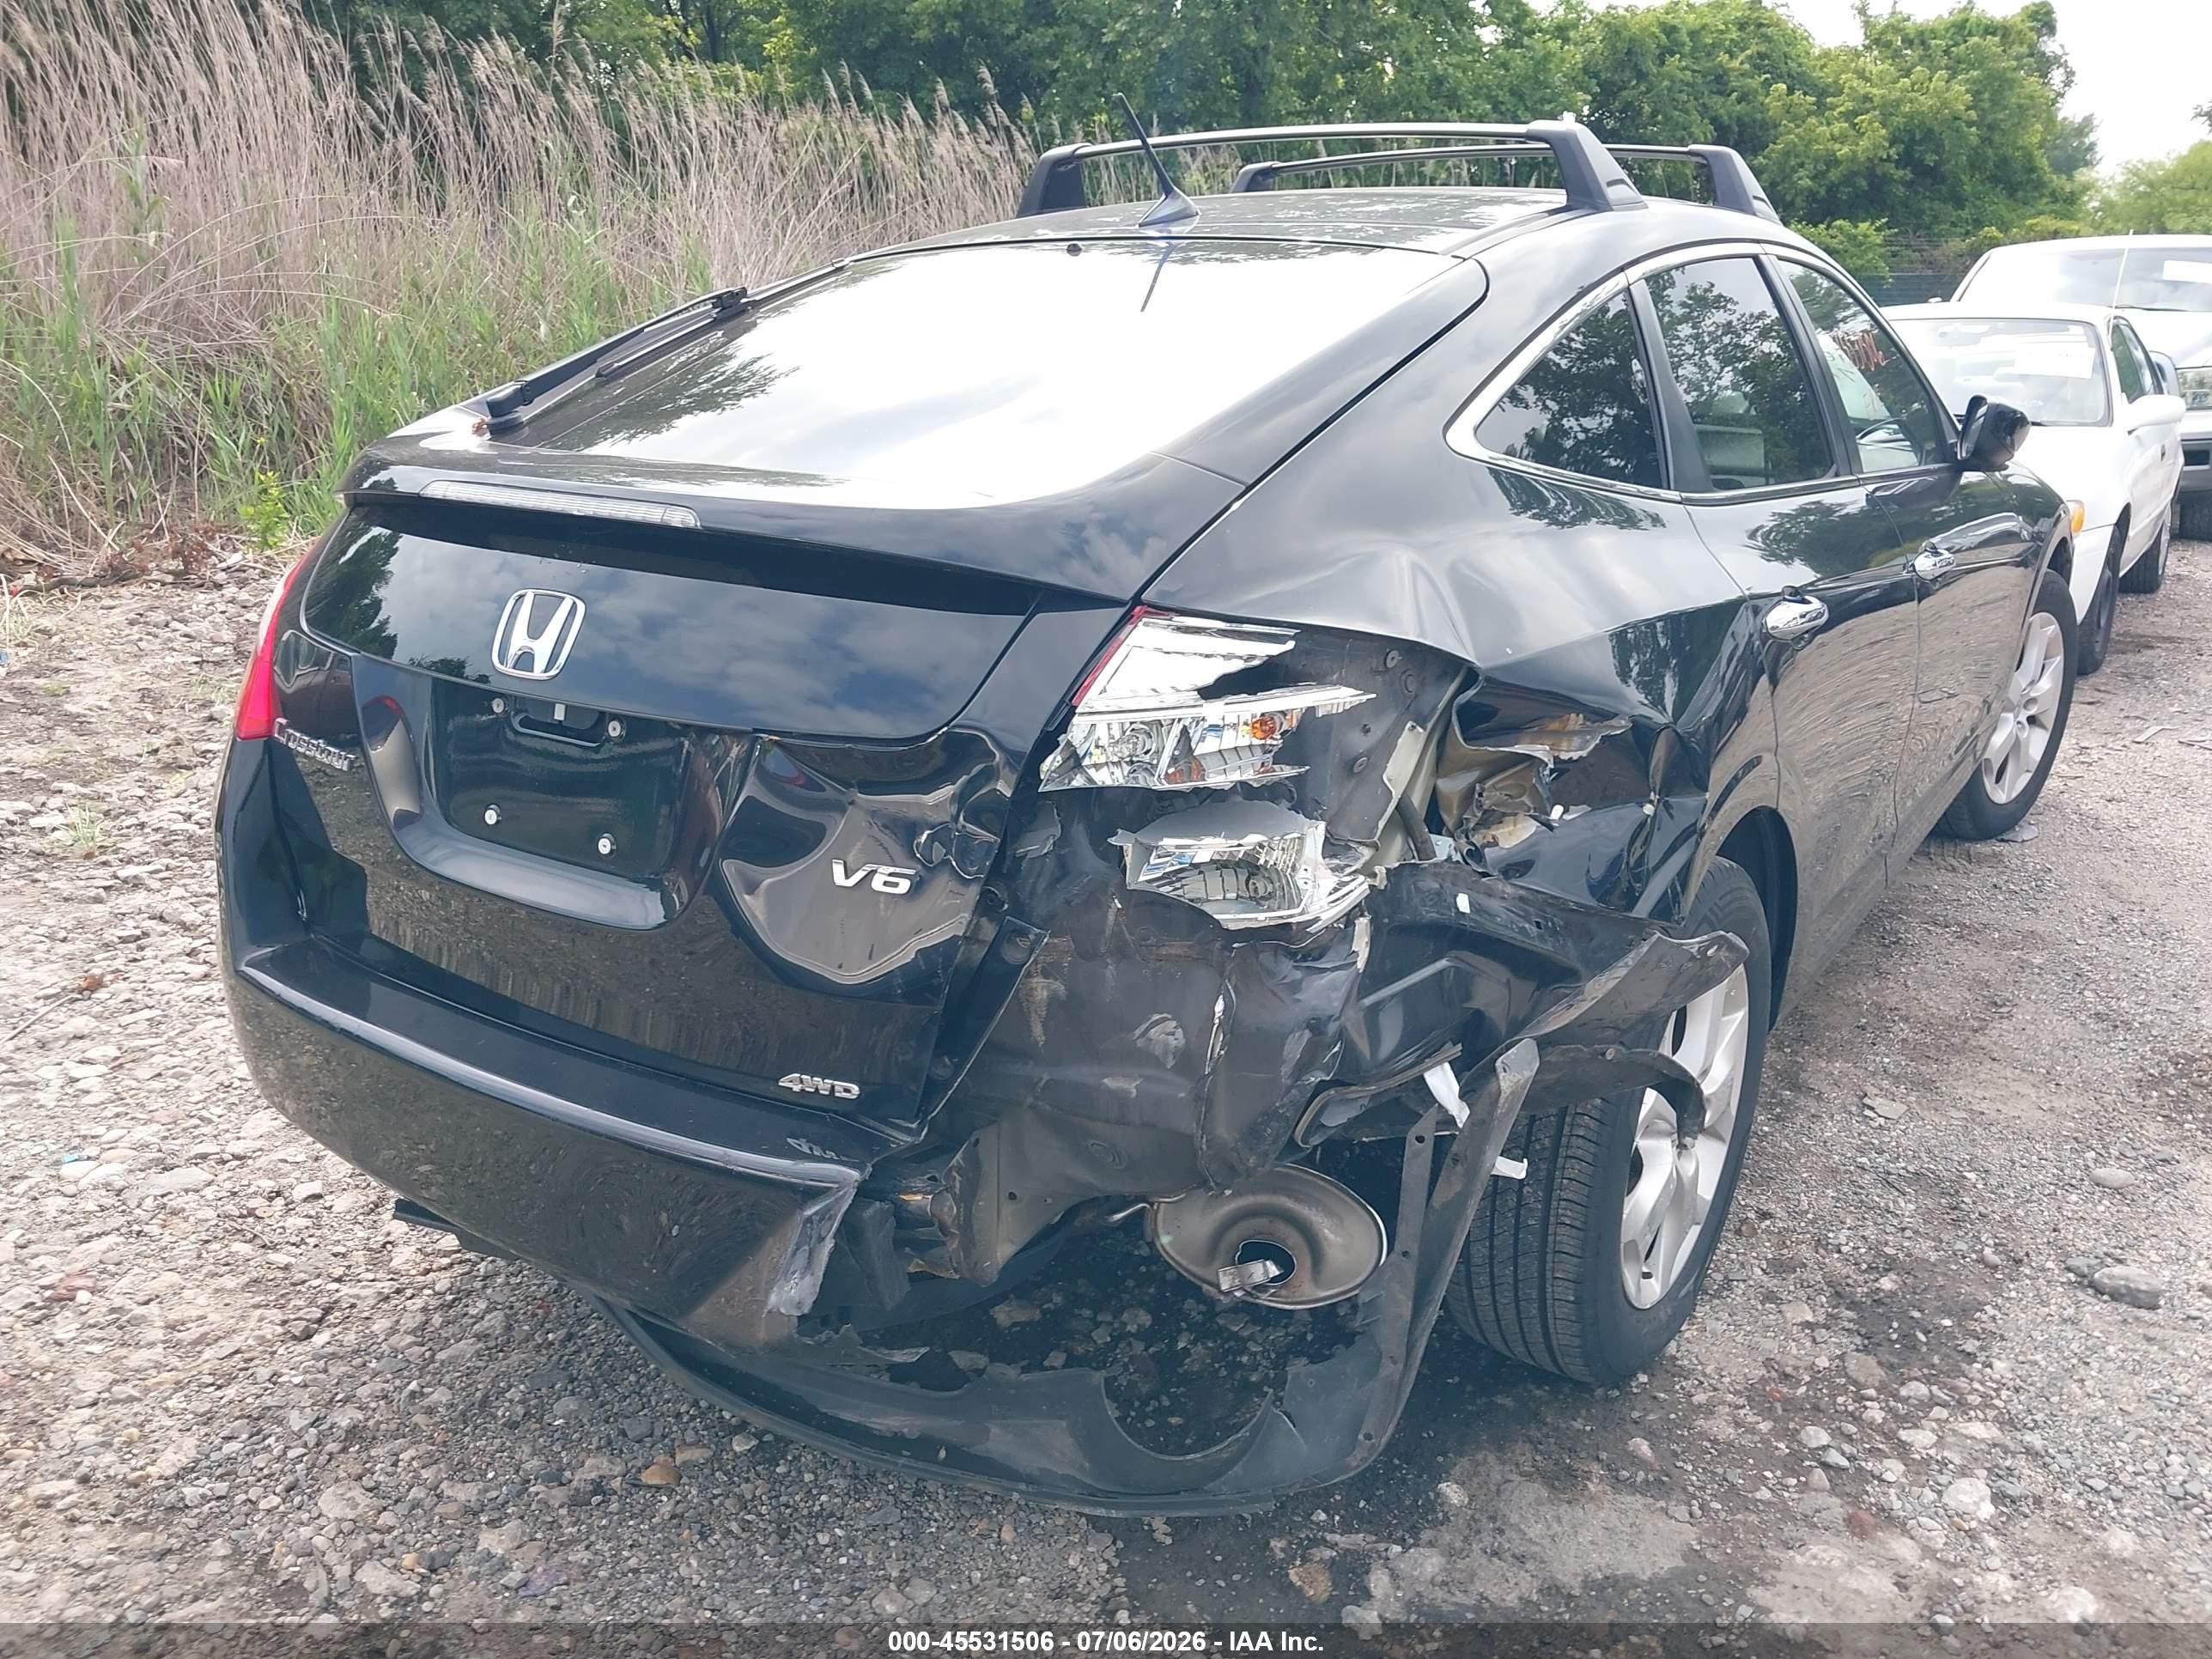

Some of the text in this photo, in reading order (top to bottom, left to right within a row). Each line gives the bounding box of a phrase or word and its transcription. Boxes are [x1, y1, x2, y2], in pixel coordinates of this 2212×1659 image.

[274, 717, 357, 771] Crosstour
[831, 859, 917, 895] V6
[778, 1073, 860, 1099] 4WD
